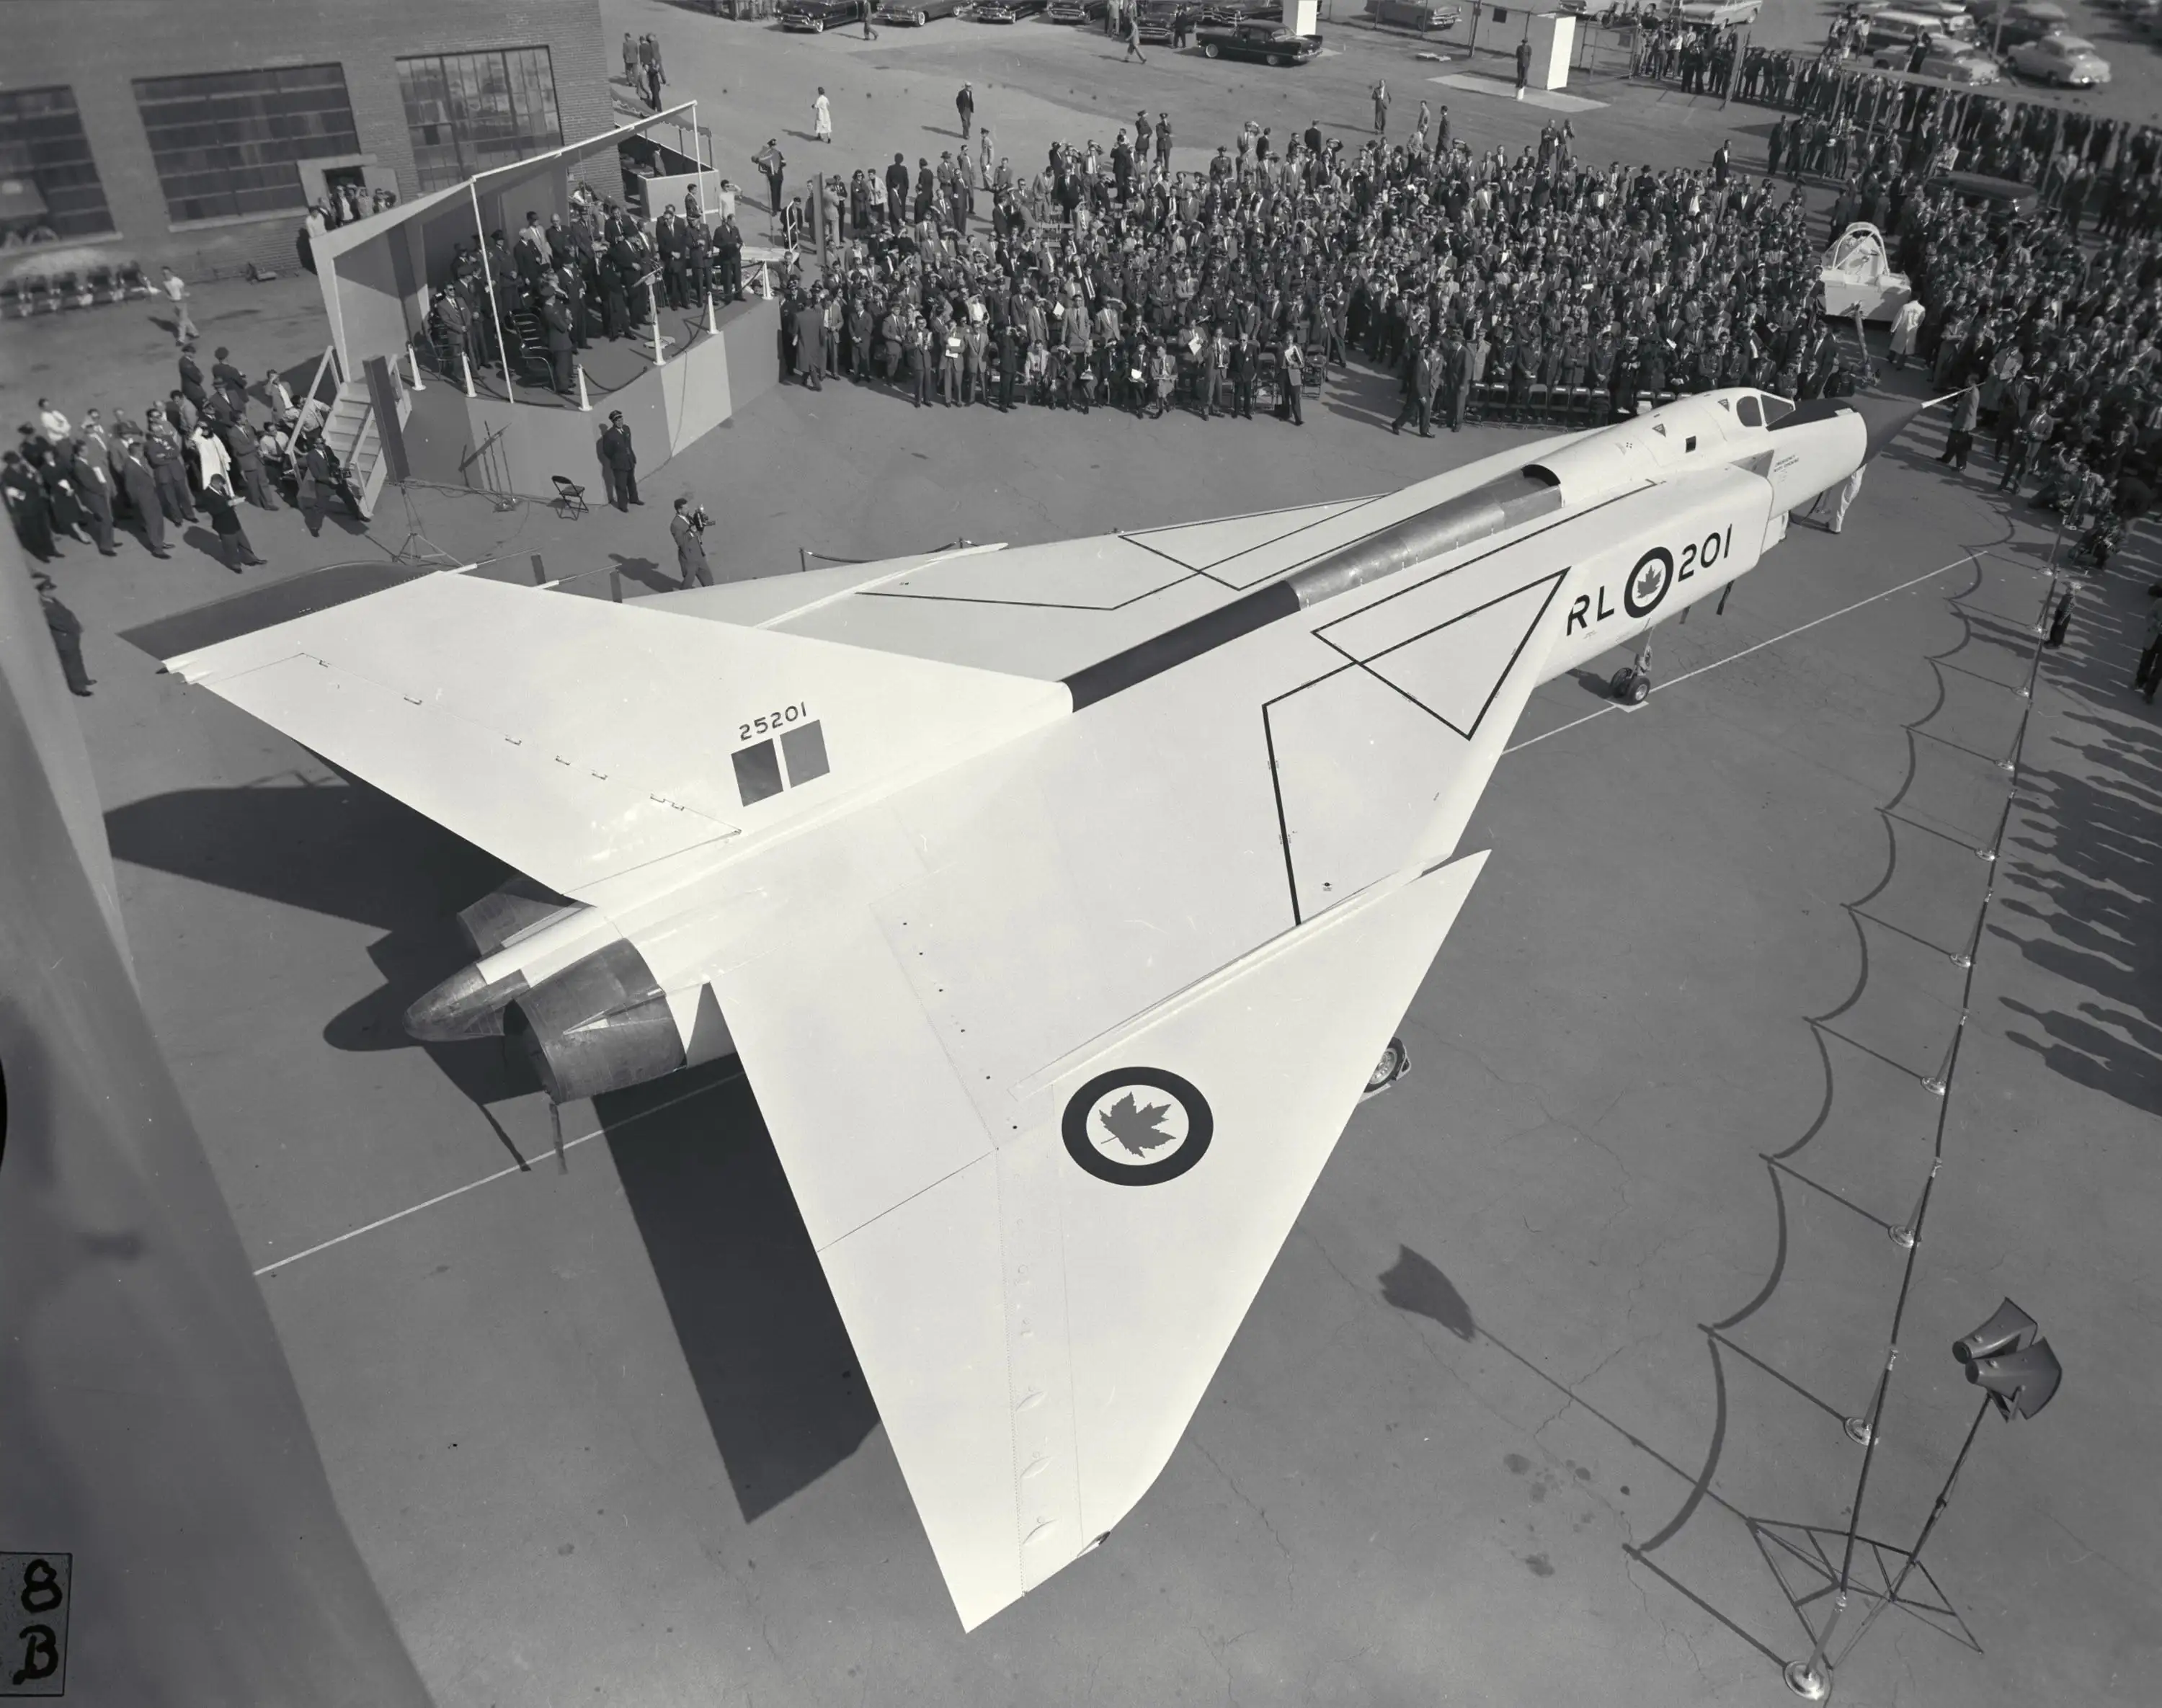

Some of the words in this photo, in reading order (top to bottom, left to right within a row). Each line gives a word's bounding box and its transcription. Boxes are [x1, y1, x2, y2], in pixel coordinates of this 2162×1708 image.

[1566, 585, 1614, 636] RL
[1678, 523, 1732, 582] 201
[739, 701, 806, 741] 25201
[21, 1558, 63, 1613] 8
